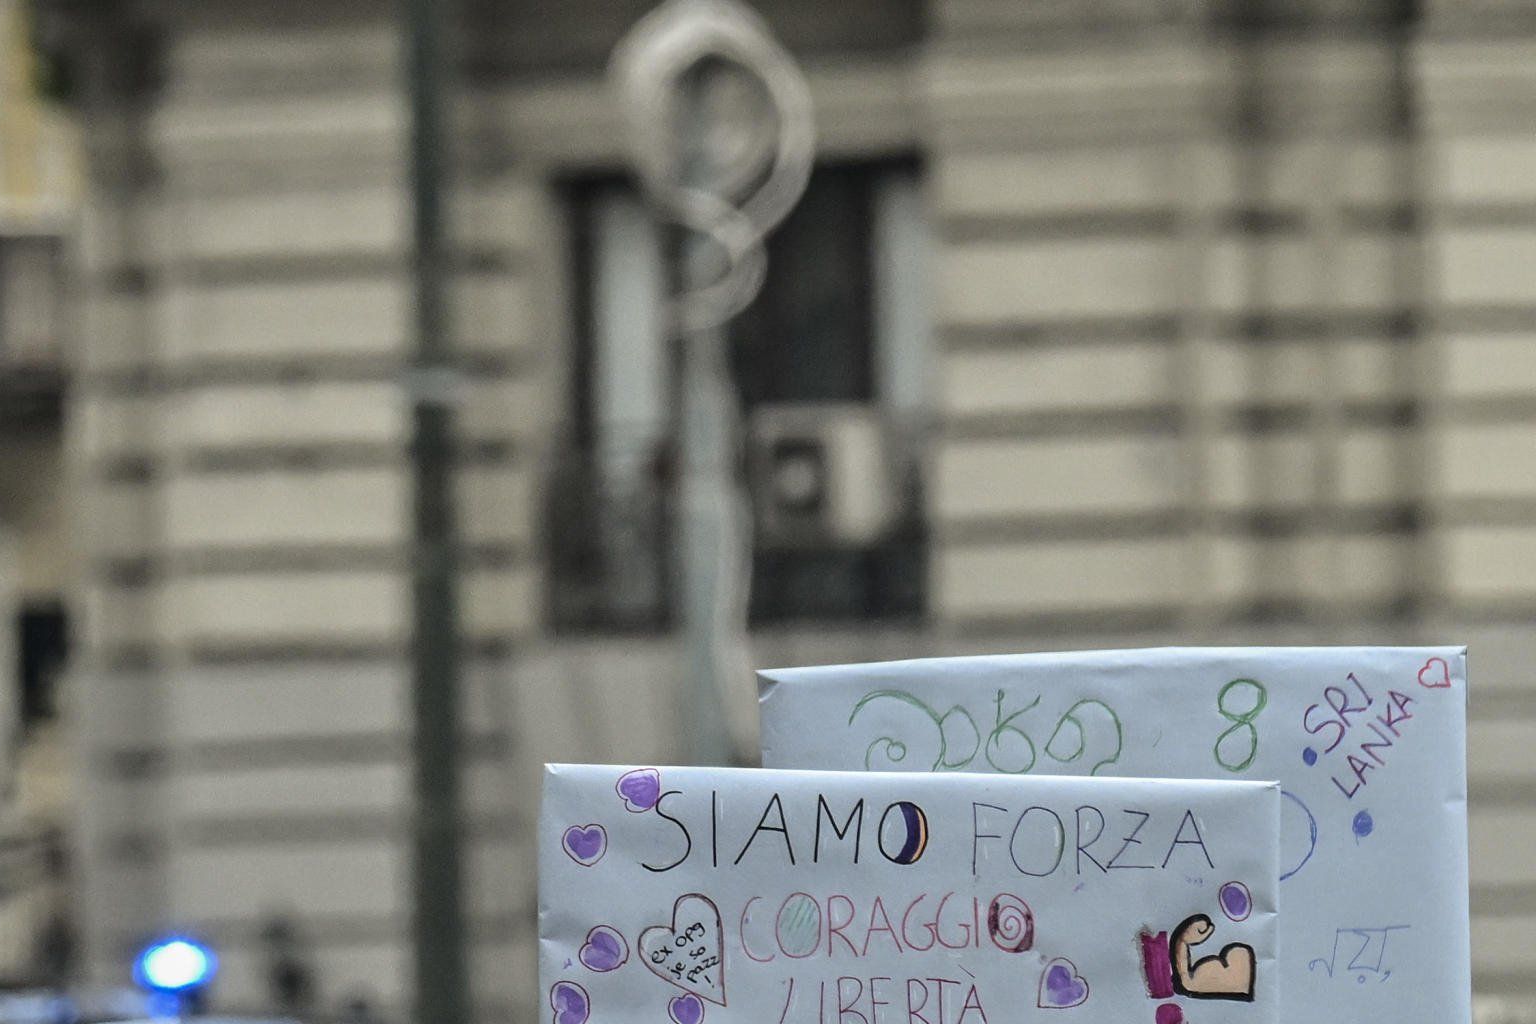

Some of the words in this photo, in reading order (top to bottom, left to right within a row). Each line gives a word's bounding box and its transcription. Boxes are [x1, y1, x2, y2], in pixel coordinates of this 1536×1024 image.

[1303, 672, 1374, 753] SRI
[1331, 689, 1414, 800] LANKA
[639, 790, 929, 872] SIAMO
[971, 801, 1214, 877] FORZA
[739, 892, 1035, 963] CORAGGIO
